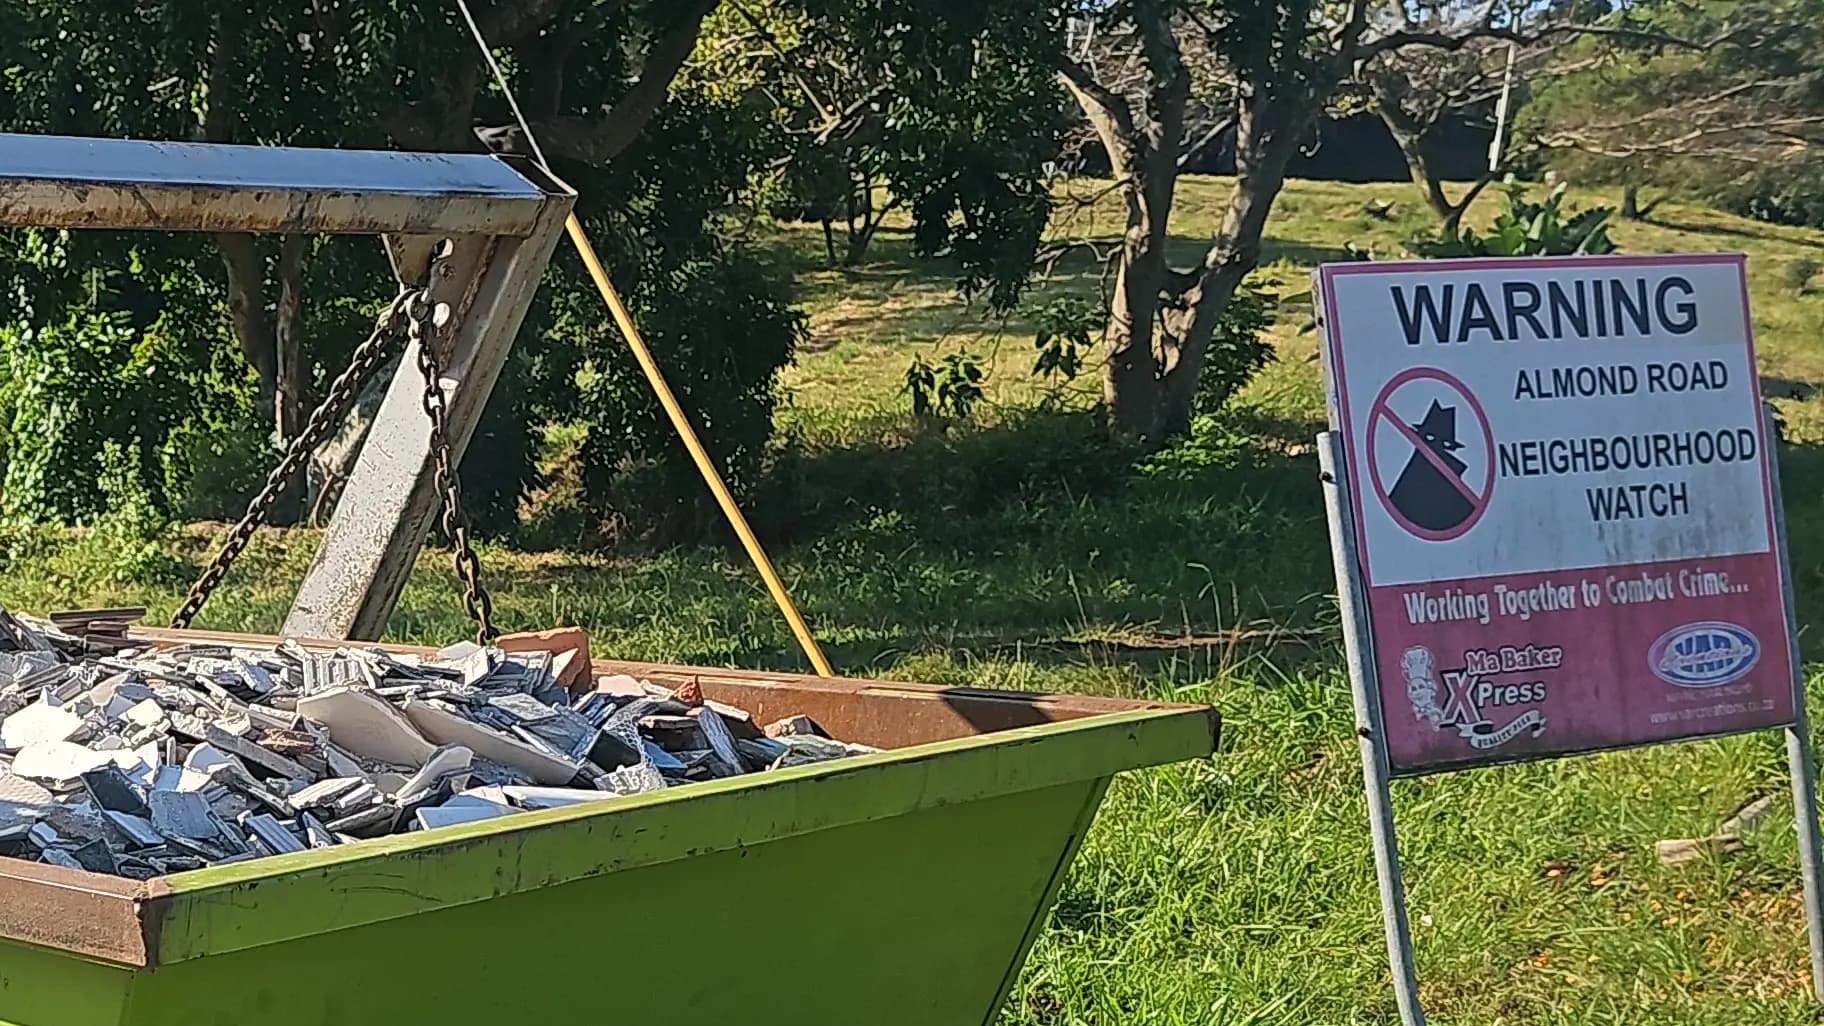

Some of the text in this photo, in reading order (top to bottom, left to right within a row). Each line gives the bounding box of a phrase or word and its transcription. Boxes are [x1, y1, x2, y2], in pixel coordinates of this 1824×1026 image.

[1391, 276, 1699, 346] WARNING
[1514, 360, 1730, 400] ALMOND ROAD
[1498, 428, 1757, 478] NEIGHBOURHOOD
[1586, 482, 1690, 522] WATCH
[1403, 588, 1490, 625] Working
[1494, 580, 1576, 620] Together
[1581, 578, 1601, 607] to
[1606, 572, 1675, 604] Combat
[1466, 645, 1562, 675] Ma Baker
